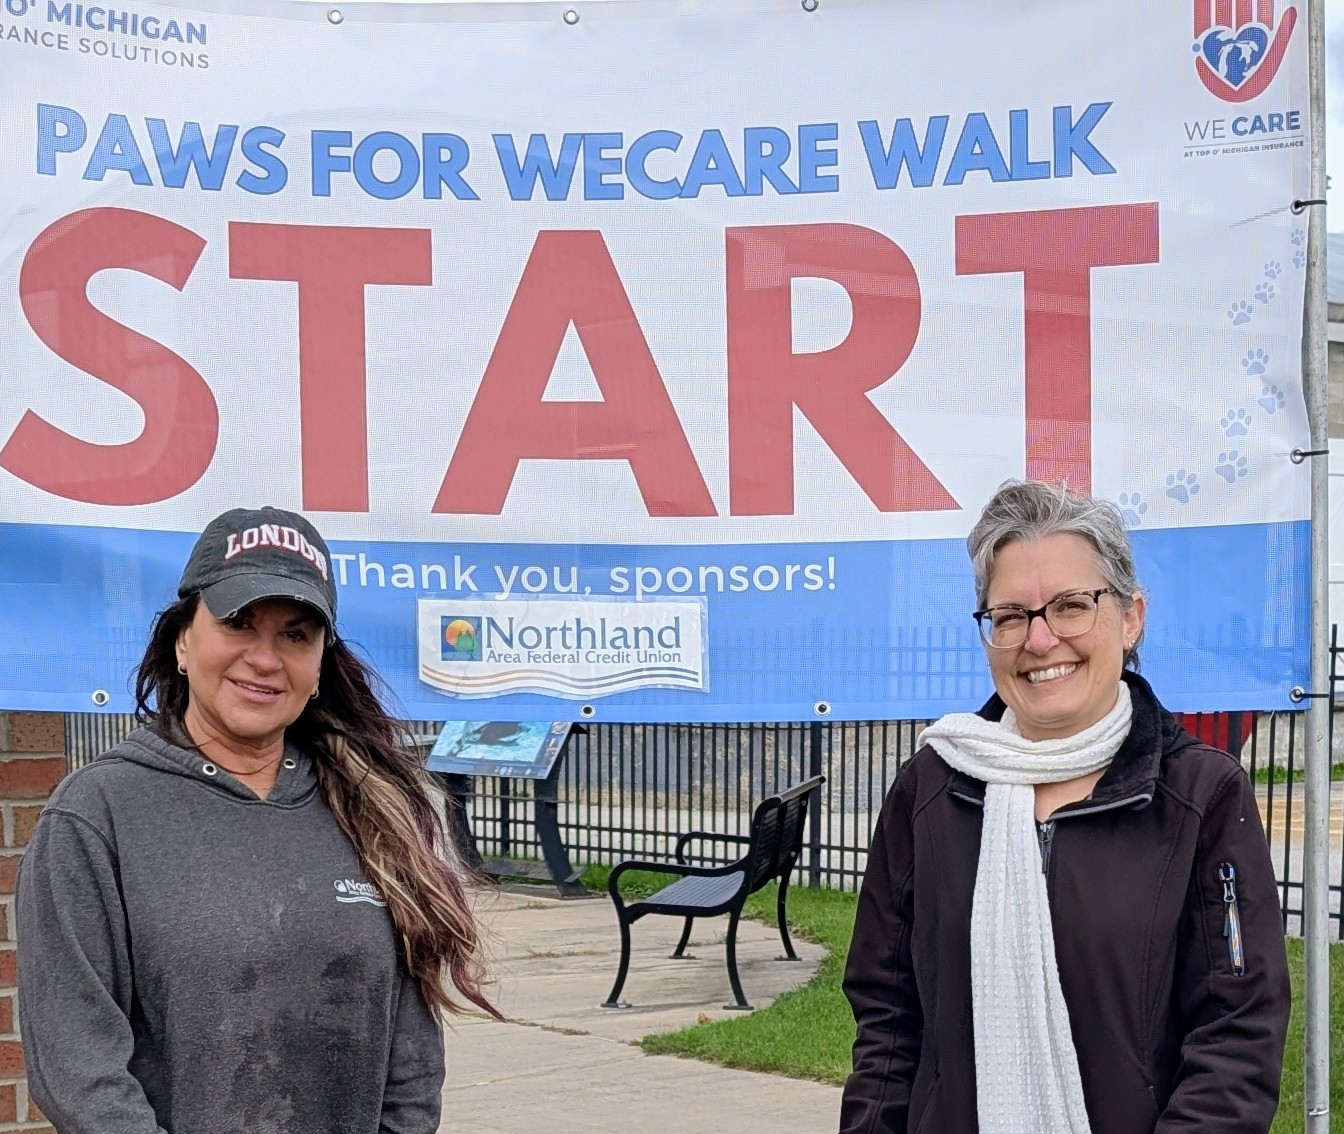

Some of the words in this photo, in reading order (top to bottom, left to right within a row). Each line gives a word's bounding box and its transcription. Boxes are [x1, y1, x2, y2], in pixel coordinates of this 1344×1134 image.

[47, 1, 207, 46] MICHIGAN
[78, 38, 209, 69] SOLUTIONS
[1183, 119, 1226, 141] WE
[1231, 110, 1301, 137] CARE
[36, 103, 288, 196] PAWS
[311, 129, 481, 201] FOR
[492, 122, 839, 201] WECARE
[857, 101, 1118, 190] WALK
[1196, 149, 1211, 157] TOP
[1222, 145, 1260, 154] MICHIGAN
[1261, 140, 1305, 151] INSURANCE
[224, 523, 329, 582] LONDON
[330, 552, 478, 592] Thank
[494, 564, 592, 601] you,
[609, 556, 836, 601] sponsors!
[485, 616, 682, 650] Northland
[486, 650, 522, 664] Area
[527, 650, 580, 664] Federal
[585, 650, 632, 664] Credit
[636, 650, 682, 663] Union
